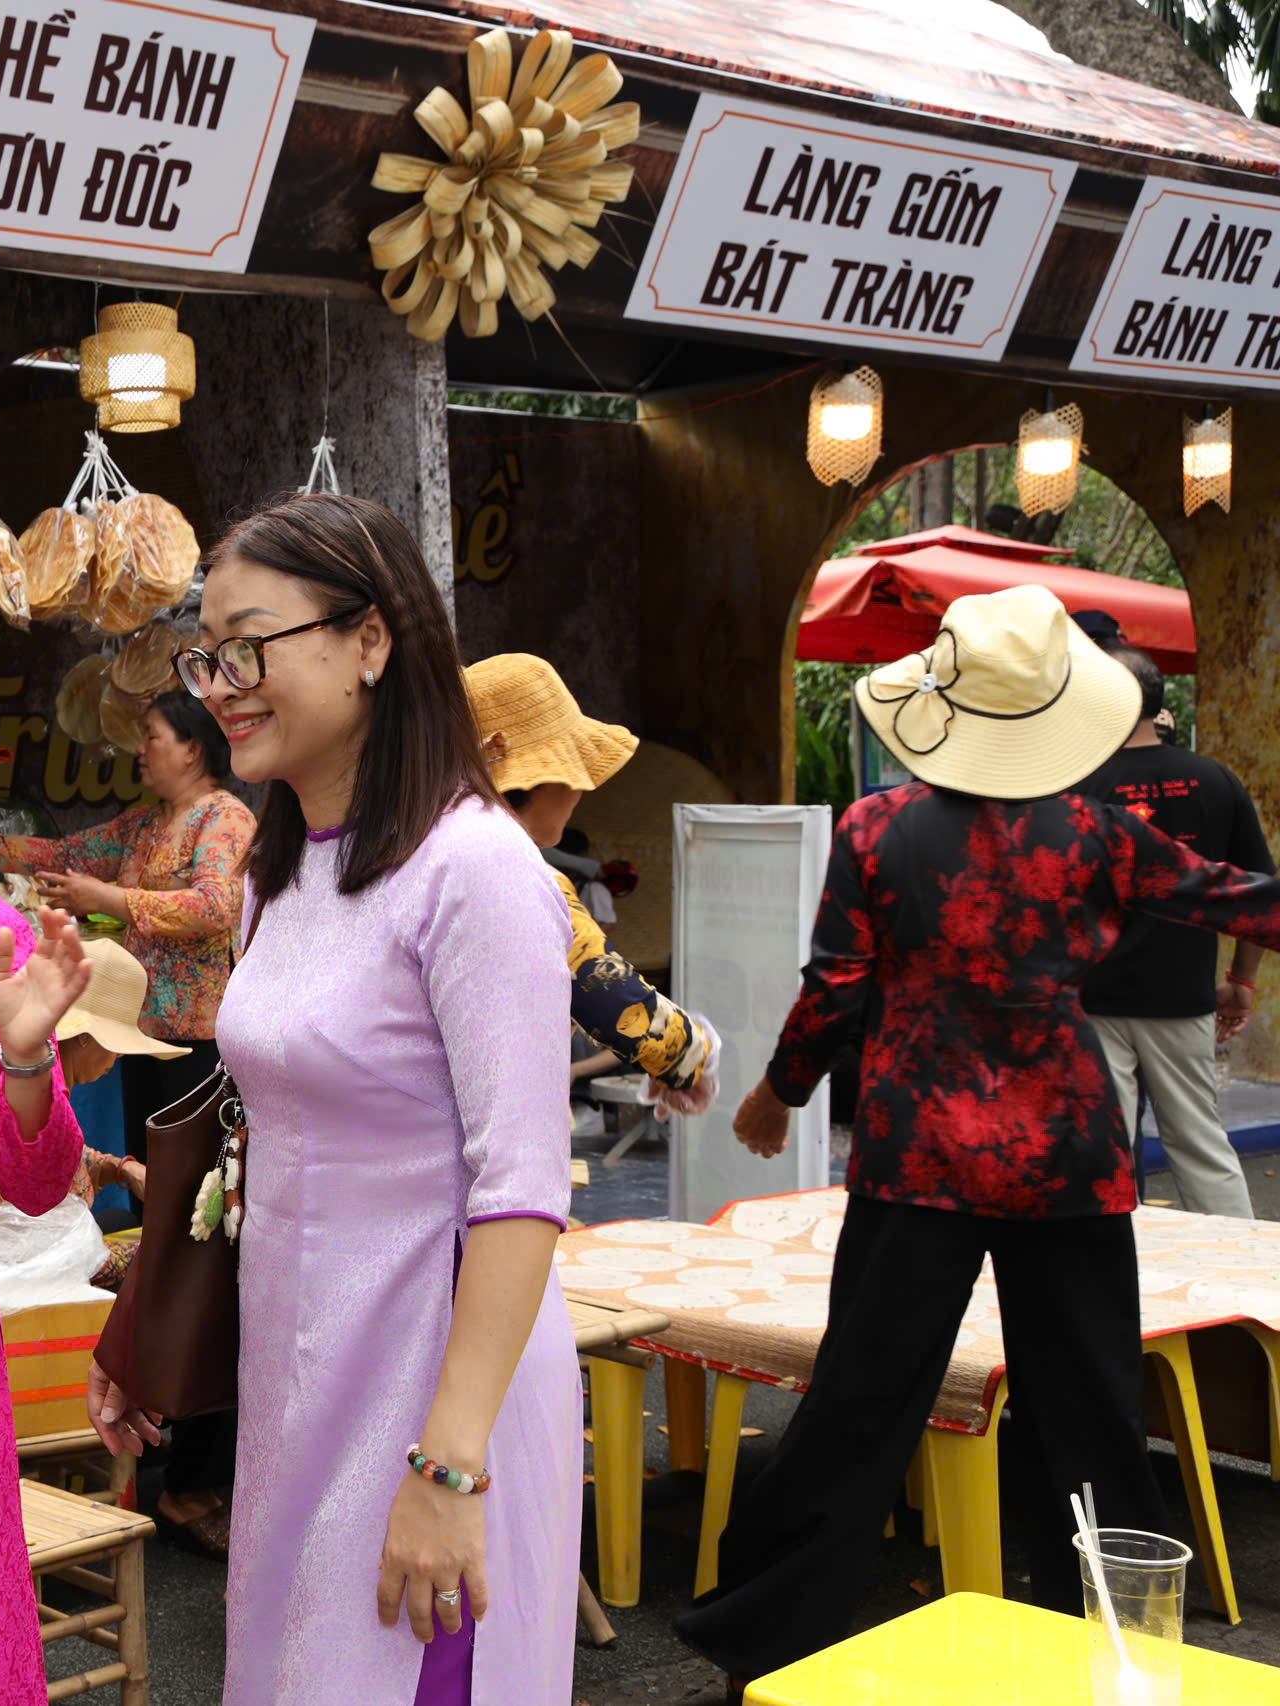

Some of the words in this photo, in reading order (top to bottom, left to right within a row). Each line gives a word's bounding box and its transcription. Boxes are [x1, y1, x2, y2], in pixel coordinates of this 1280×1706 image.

[84, 31, 235, 130] BÁNH
[79, 141, 192, 231] ĐỐC
[743, 144, 881, 229] LÀNG
[888, 167, 1002, 247] GỐM
[700, 239, 808, 313] BÁT
[821, 259, 974, 335] TRÀNG
[1162, 213, 1272, 285] LÀNG
[1113, 296, 1229, 363] BÁNH
[1234, 313, 1280, 371] TR
